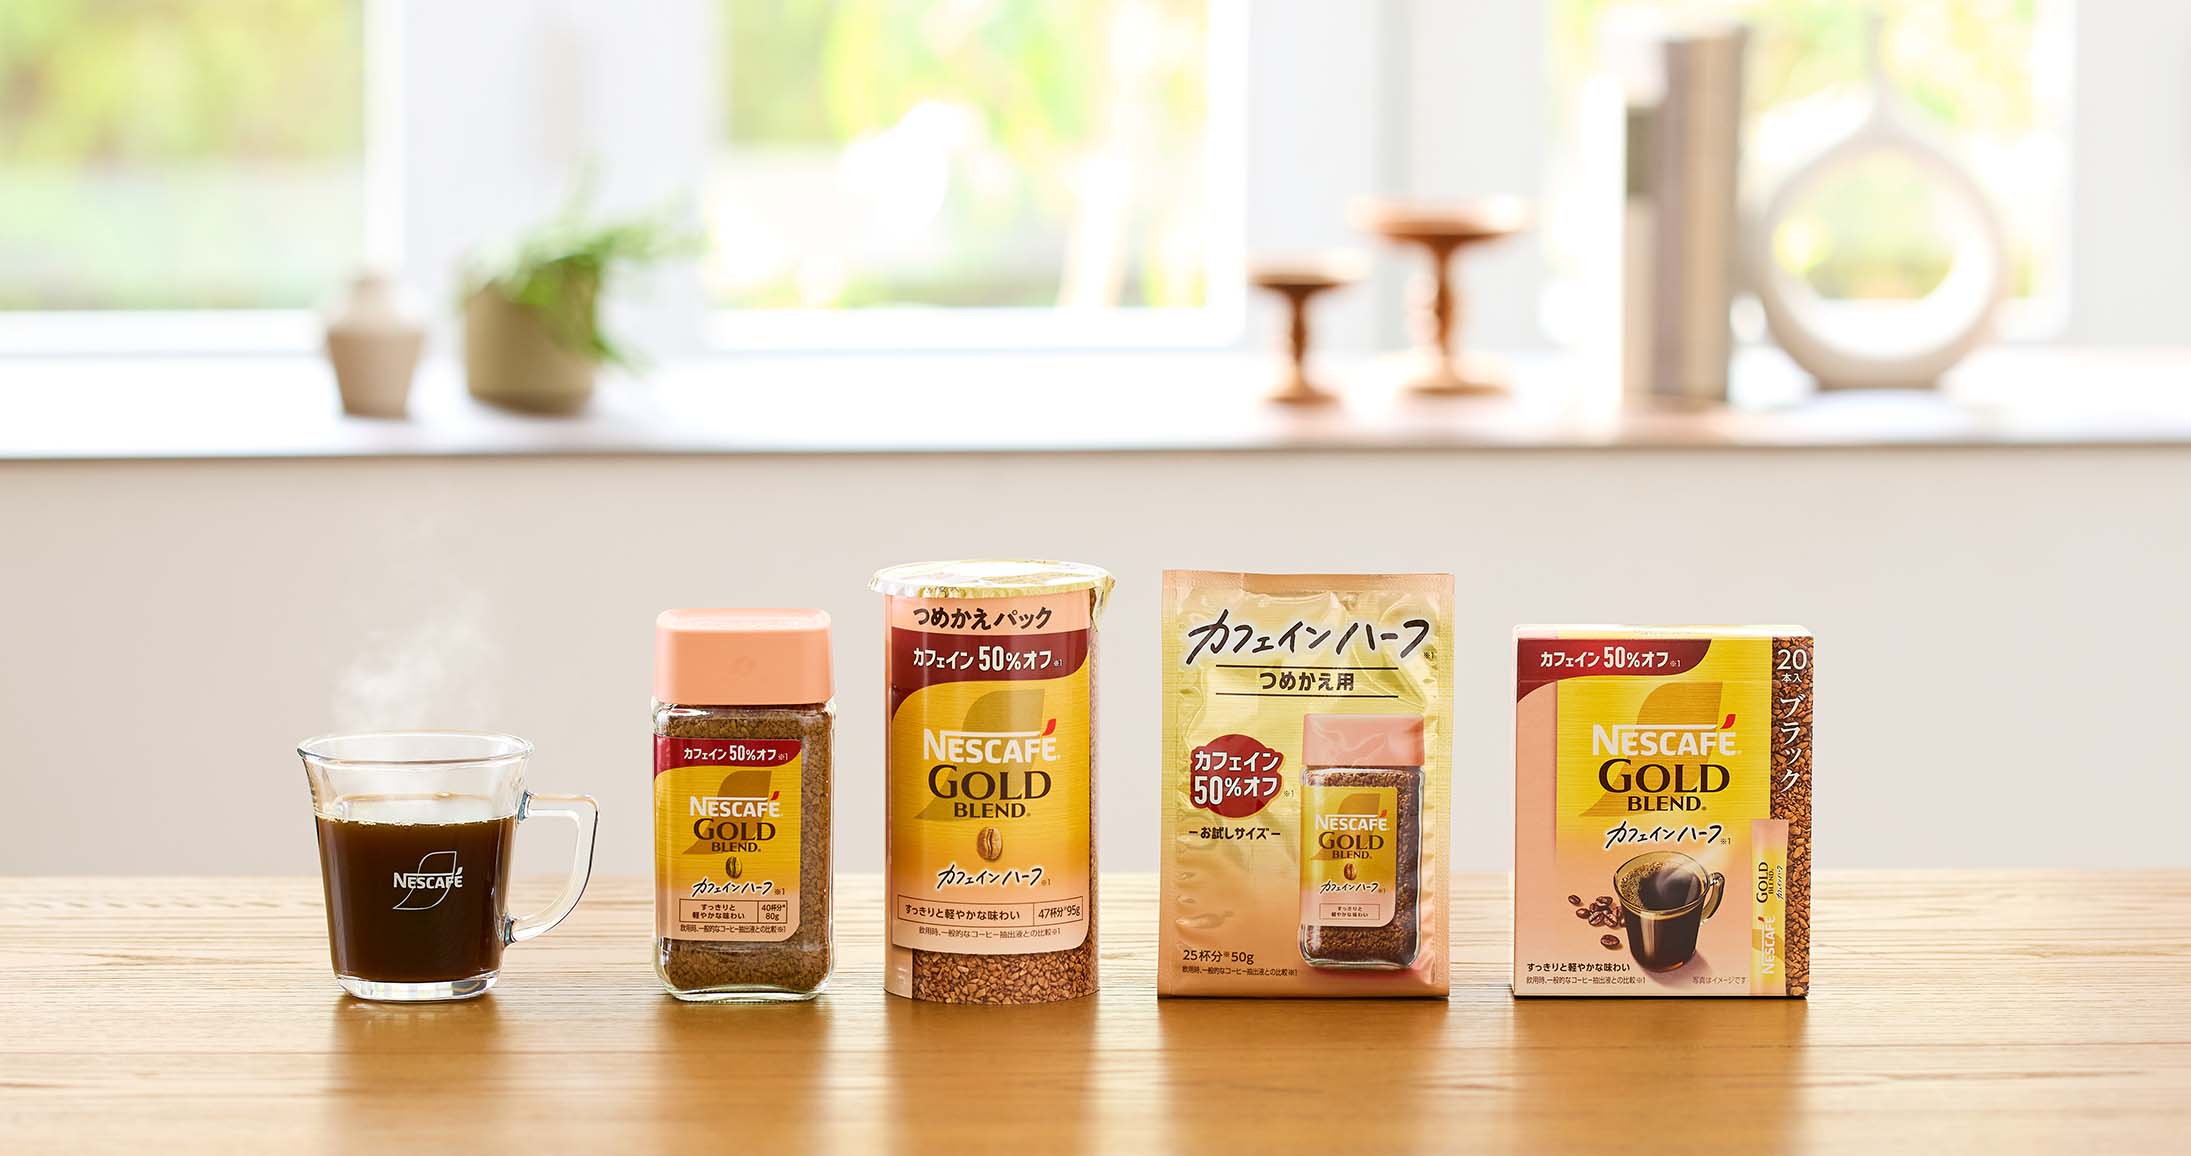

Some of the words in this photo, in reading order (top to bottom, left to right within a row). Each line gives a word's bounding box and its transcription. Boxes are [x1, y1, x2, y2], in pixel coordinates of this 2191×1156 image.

[913, 606, 1052, 630] つめかえパック
[1185, 608, 1430, 665] カフェインハーフ
[1777, 649, 1807, 670] 20
[1258, 671, 1355, 692] つめかえ用
[1781, 672, 1802, 683] 本入
[923, 718, 1057, 764] NESCAFÉ
[1592, 713, 1737, 756] NESCAFÉ
[1780, 693, 1806, 792] ブラック
[1194, 750, 1279, 772] カフェイン
[928, 764, 1052, 801] GOLD
[1599, 758, 1730, 793] GOLD
[1194, 775, 1278, 805] 50%オフ
[689, 790, 780, 817] NESCAFÉ
[953, 802, 1026, 818] BLEND
[1627, 795, 1702, 812] BLEND
[693, 818, 776, 841] GOLD
[1314, 809, 1388, 831] NESCAFÉ
[1318, 831, 1384, 850] GOLD
[1605, 820, 1722, 848] カフェインハーフ
[711, 842, 758, 852] BLEND
[1332, 850, 1370, 859] BLEND
[393, 866, 463, 889] NESCAFÉ
[691, 878, 773, 897] カフェインハーフ
[936, 864, 1043, 889] カフェインハーフ
[1319, 880, 1379, 895] カフェインハーフ
[1756, 861, 1769, 904] GOLD
[692, 912, 745, 920] 軽やかな味わい
[700, 903, 736, 912] すっきりと
[765, 912, 780, 921] 80g
[905, 904, 1020, 921] すっきりと軽やかな味わい
[1758, 915, 1776, 975] NESCAFÉ
[1527, 962, 1631, 972] すっきりと軽やかな味わい
